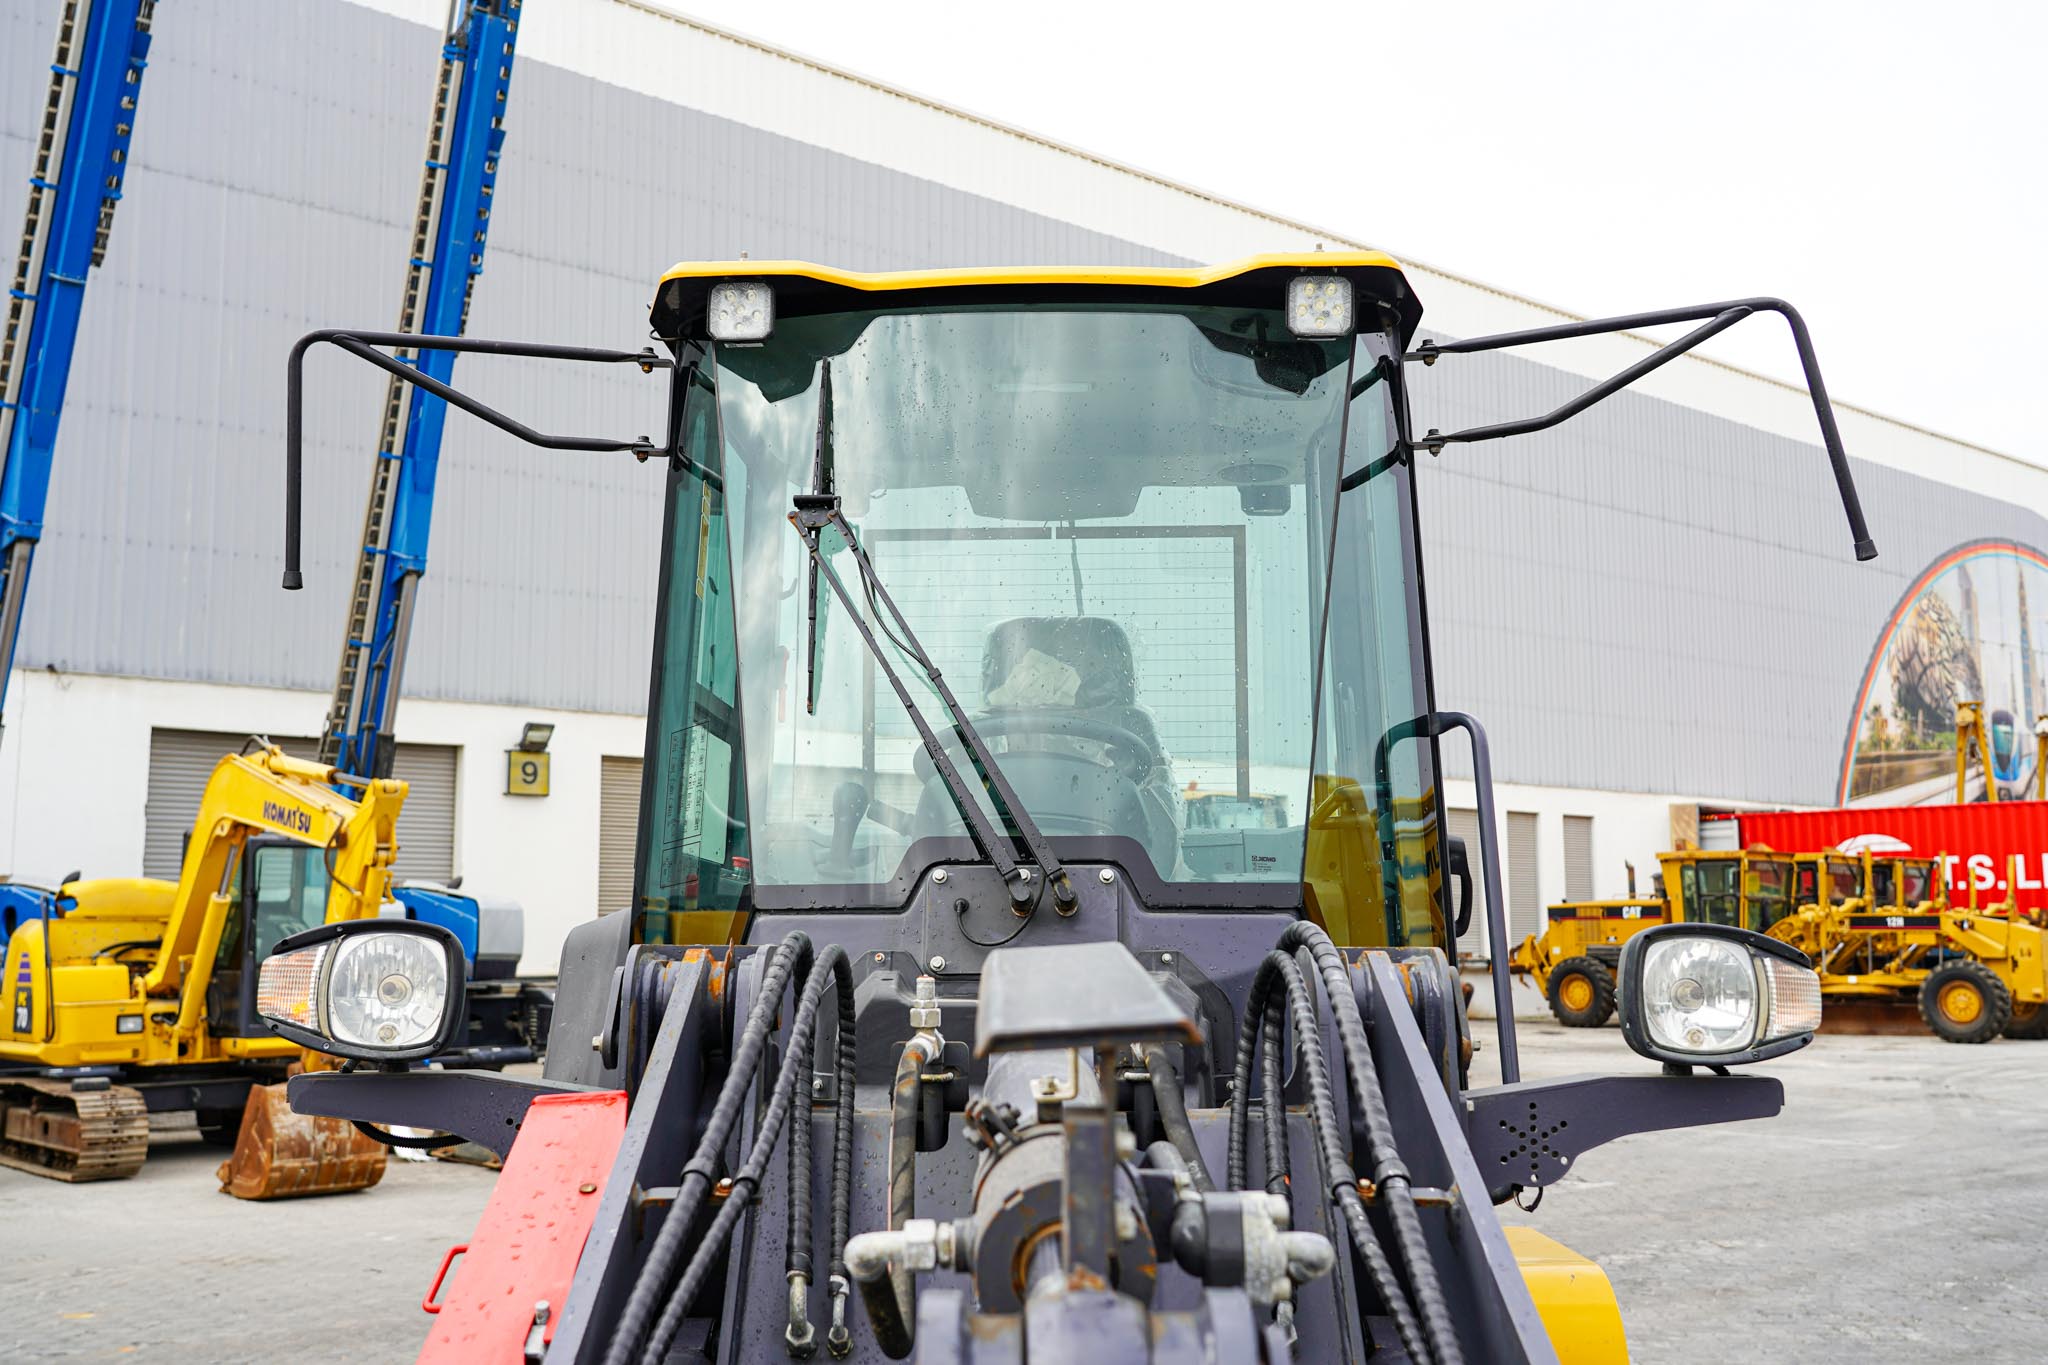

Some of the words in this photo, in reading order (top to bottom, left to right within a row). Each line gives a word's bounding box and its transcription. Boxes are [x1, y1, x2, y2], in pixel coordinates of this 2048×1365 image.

[521, 761, 538, 785] 9
[263, 800, 312, 834] KOMATSU
[1622, 905, 1643, 920] CAT
[16, 1006, 29, 1029] 70
